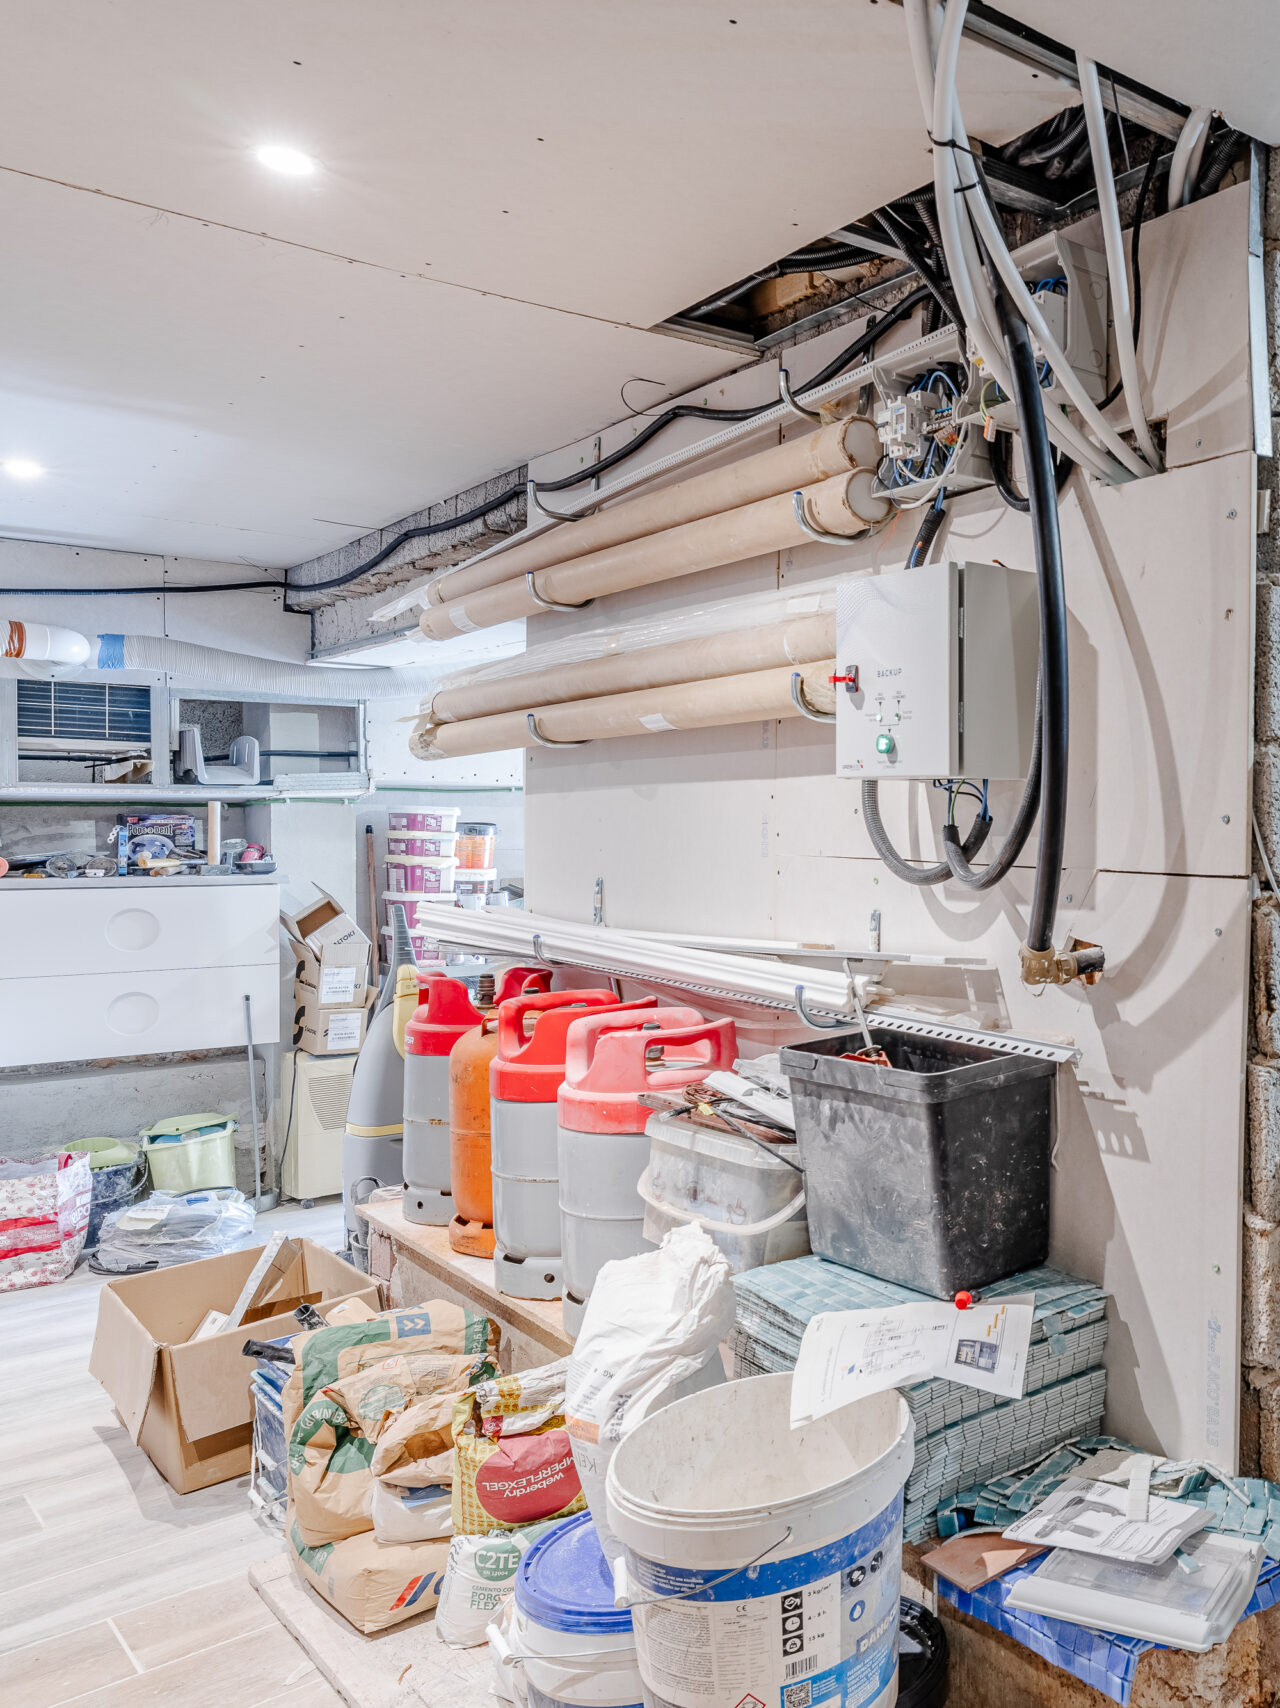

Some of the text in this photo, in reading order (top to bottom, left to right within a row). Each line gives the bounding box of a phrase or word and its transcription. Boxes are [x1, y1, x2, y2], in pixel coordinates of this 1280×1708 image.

[877, 668, 902, 678] BACKUP
[503, 1472, 565, 1498] weberdry
[475, 1550, 519, 1569] C2TE
[471, 1584, 502, 1593] CEMENTO
